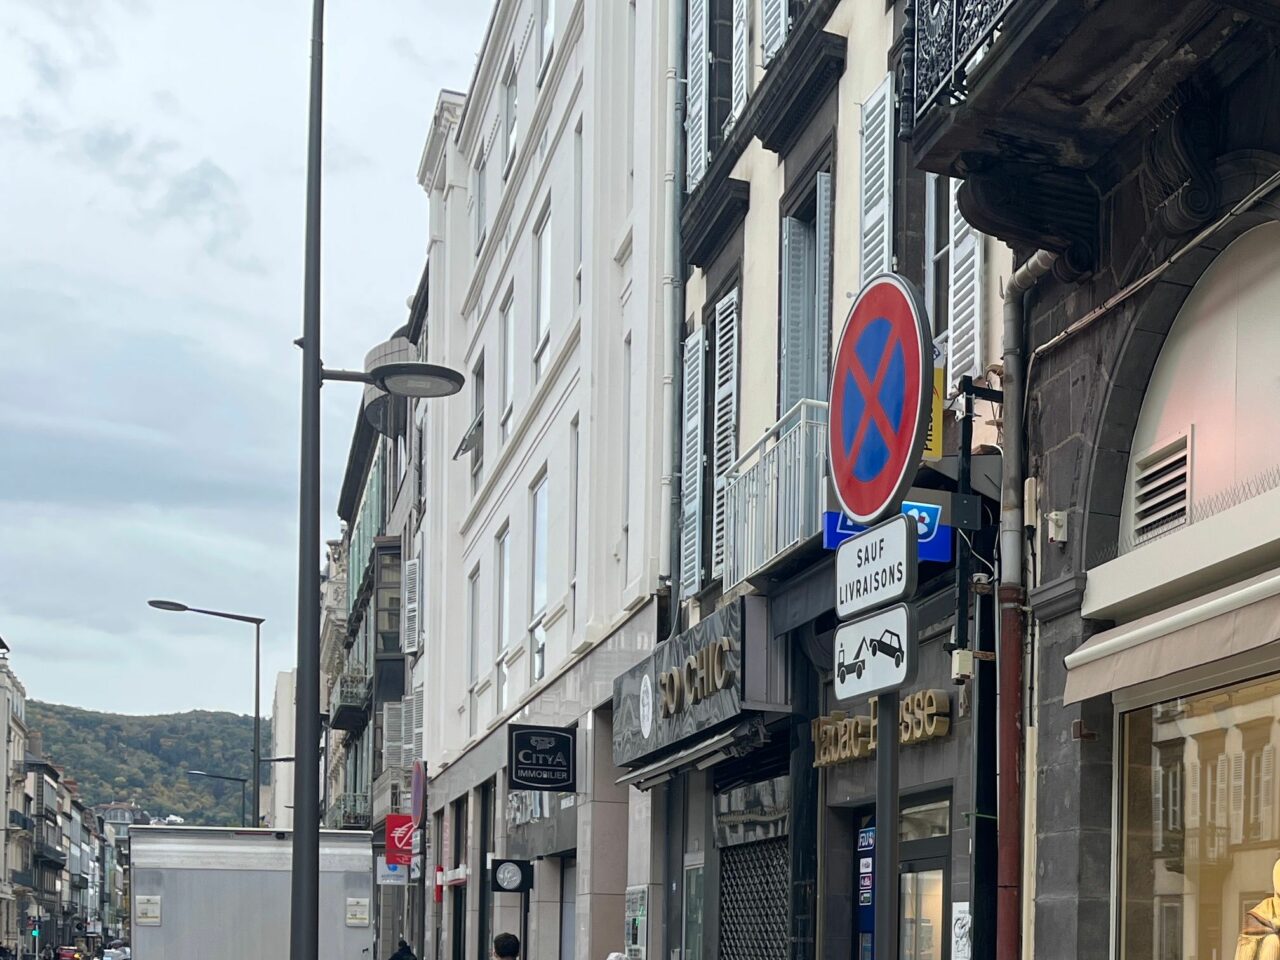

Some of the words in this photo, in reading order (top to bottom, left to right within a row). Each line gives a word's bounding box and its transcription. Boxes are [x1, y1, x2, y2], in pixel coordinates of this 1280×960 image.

[857, 537, 884, 568] SAUF
[840, 561, 903, 606] LIVRAISONS
[684, 636, 735, 706] CHIC
[517, 769, 568, 780] IMMOBILIER
